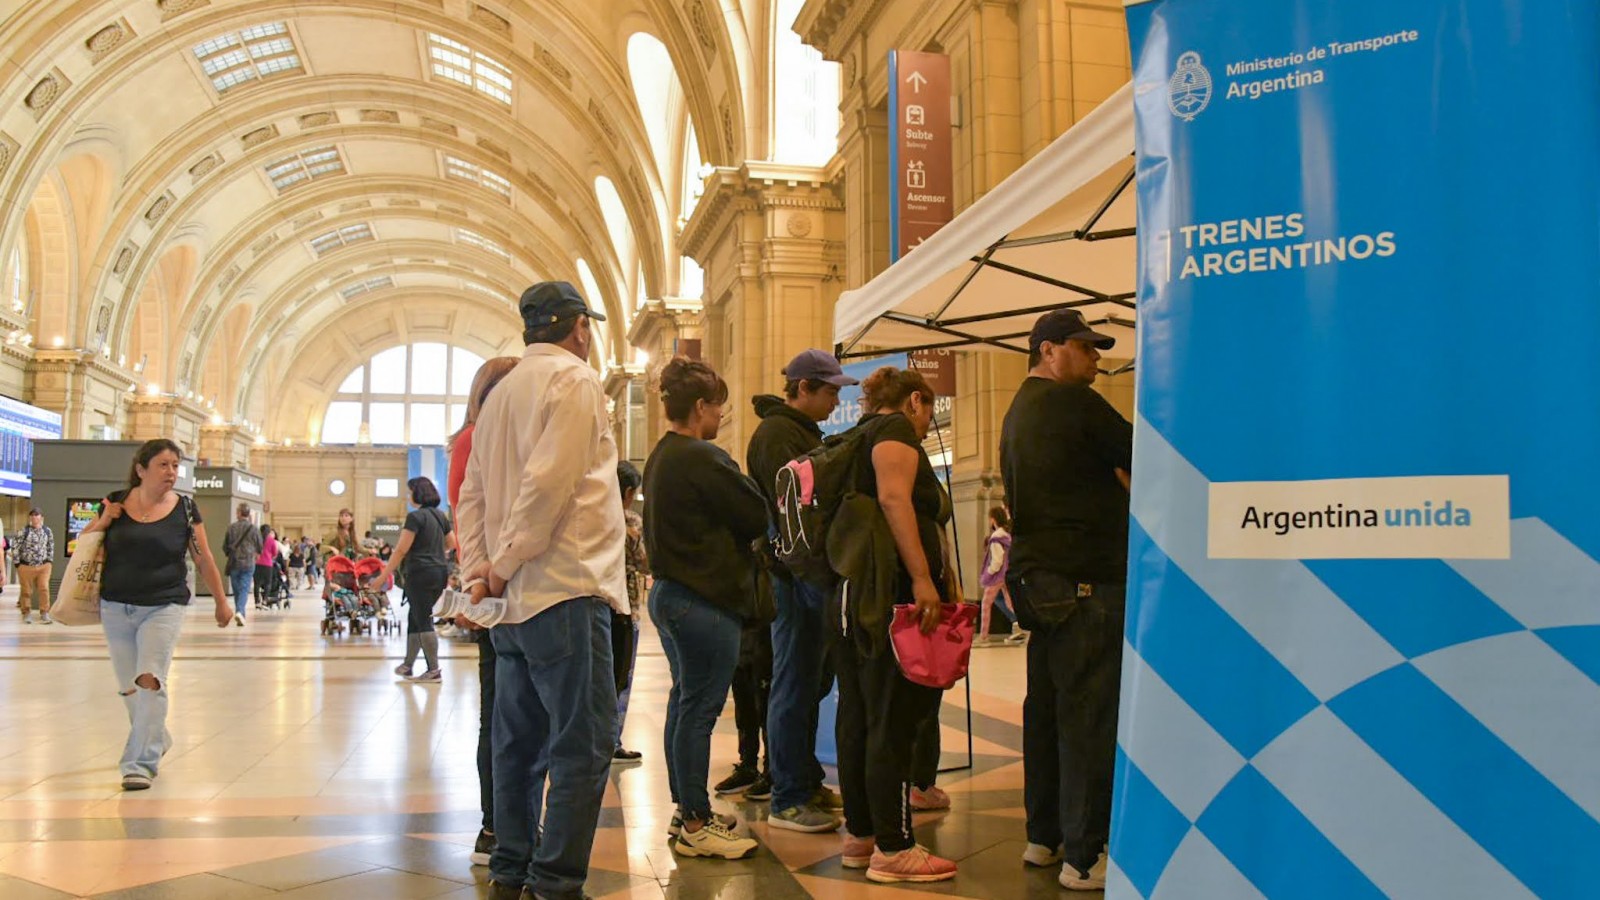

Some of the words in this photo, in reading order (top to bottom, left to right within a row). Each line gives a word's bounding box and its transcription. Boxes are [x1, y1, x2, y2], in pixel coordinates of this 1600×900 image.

[1226, 52, 1304, 77] Ministerio
[1306, 46, 1326, 62] de
[1328, 29, 1419, 56] Transporte
[1226, 68, 1325, 100] Argentina
[905, 129, 934, 140] Subte
[907, 192, 946, 203] Ascensor
[1180, 212, 1304, 249] TRENES
[1179, 231, 1396, 280] ARGENTINOS
[934, 396, 952, 415] SCO
[1241, 503, 1378, 536] Argentina
[1384, 500, 1471, 526] unida
